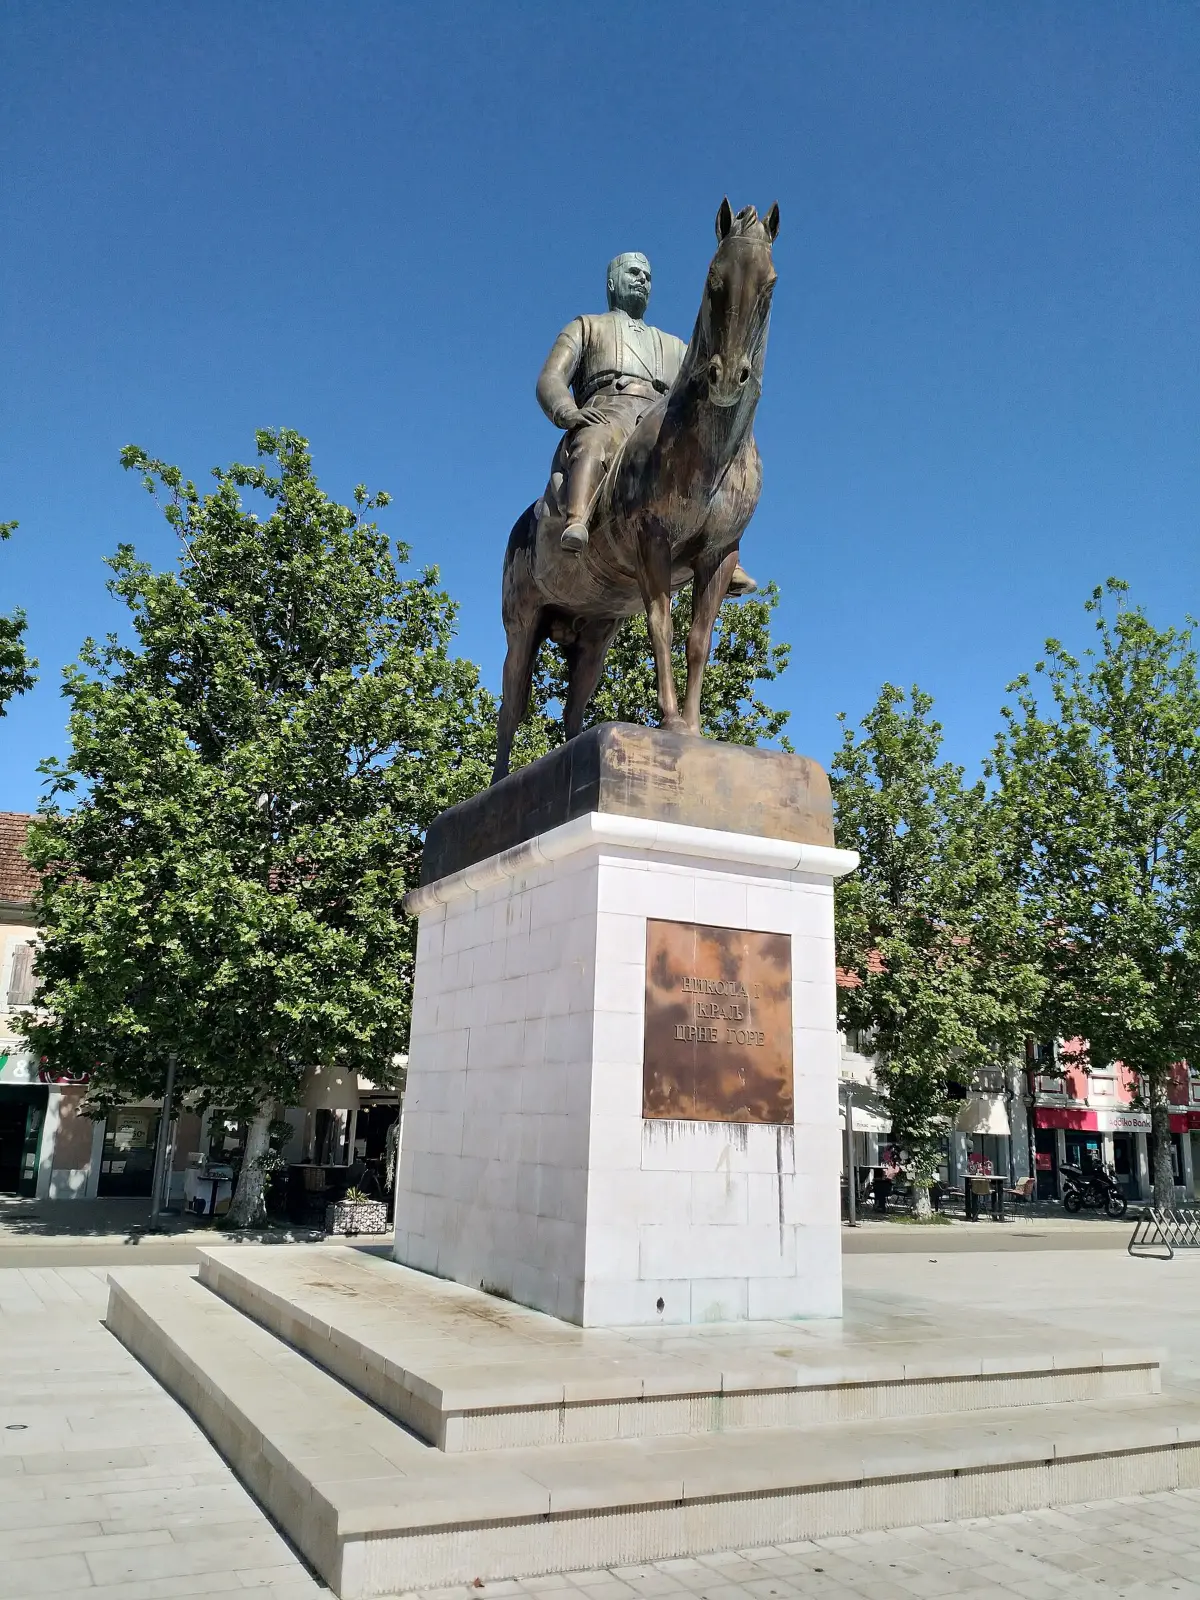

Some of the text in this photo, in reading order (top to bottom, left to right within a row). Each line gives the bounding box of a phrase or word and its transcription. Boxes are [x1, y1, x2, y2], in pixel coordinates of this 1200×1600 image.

[681, 976, 749, 998] НИКОЛА
[697, 1001, 744, 1021] КРАЉ
[673, 1024, 765, 1046] ЦРНЕ ГОРЕ
[1133, 1119, 1151, 1128] Bank
